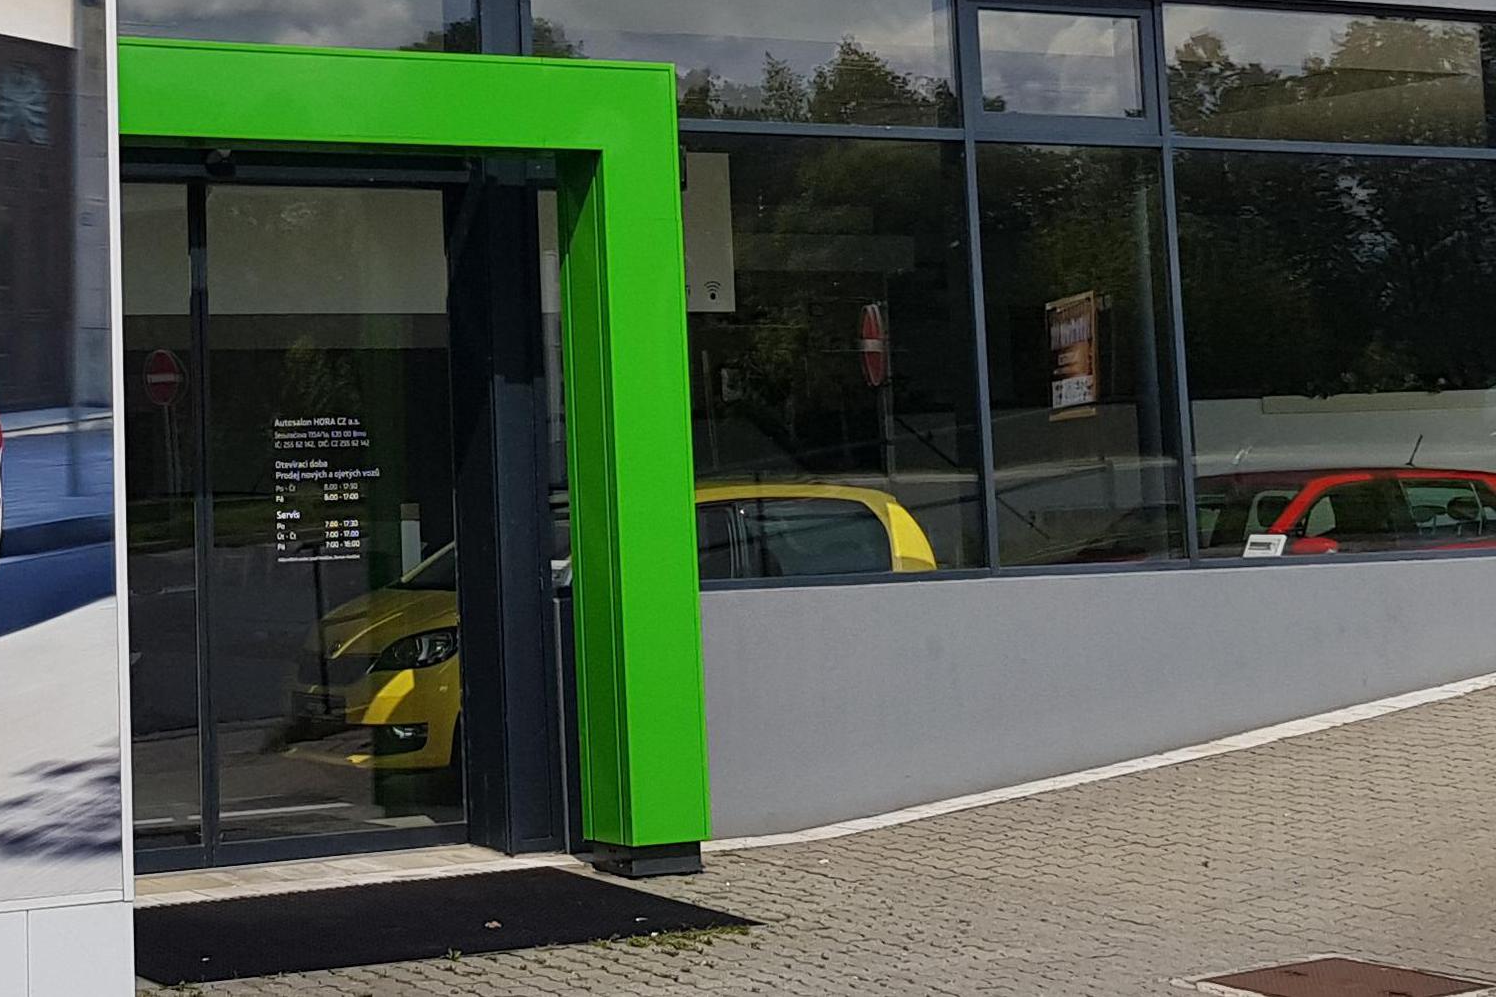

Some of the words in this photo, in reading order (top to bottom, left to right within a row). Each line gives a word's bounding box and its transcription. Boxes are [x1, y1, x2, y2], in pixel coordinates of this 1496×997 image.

[274, 418, 312, 427] Autosalon
[313, 418, 336, 426] HORA
[337, 417, 346, 425] CZ
[309, 459, 328, 468] doba
[276, 471, 300, 481] Prodej
[301, 470, 327, 481] nových
[276, 510, 300, 520] Servis
